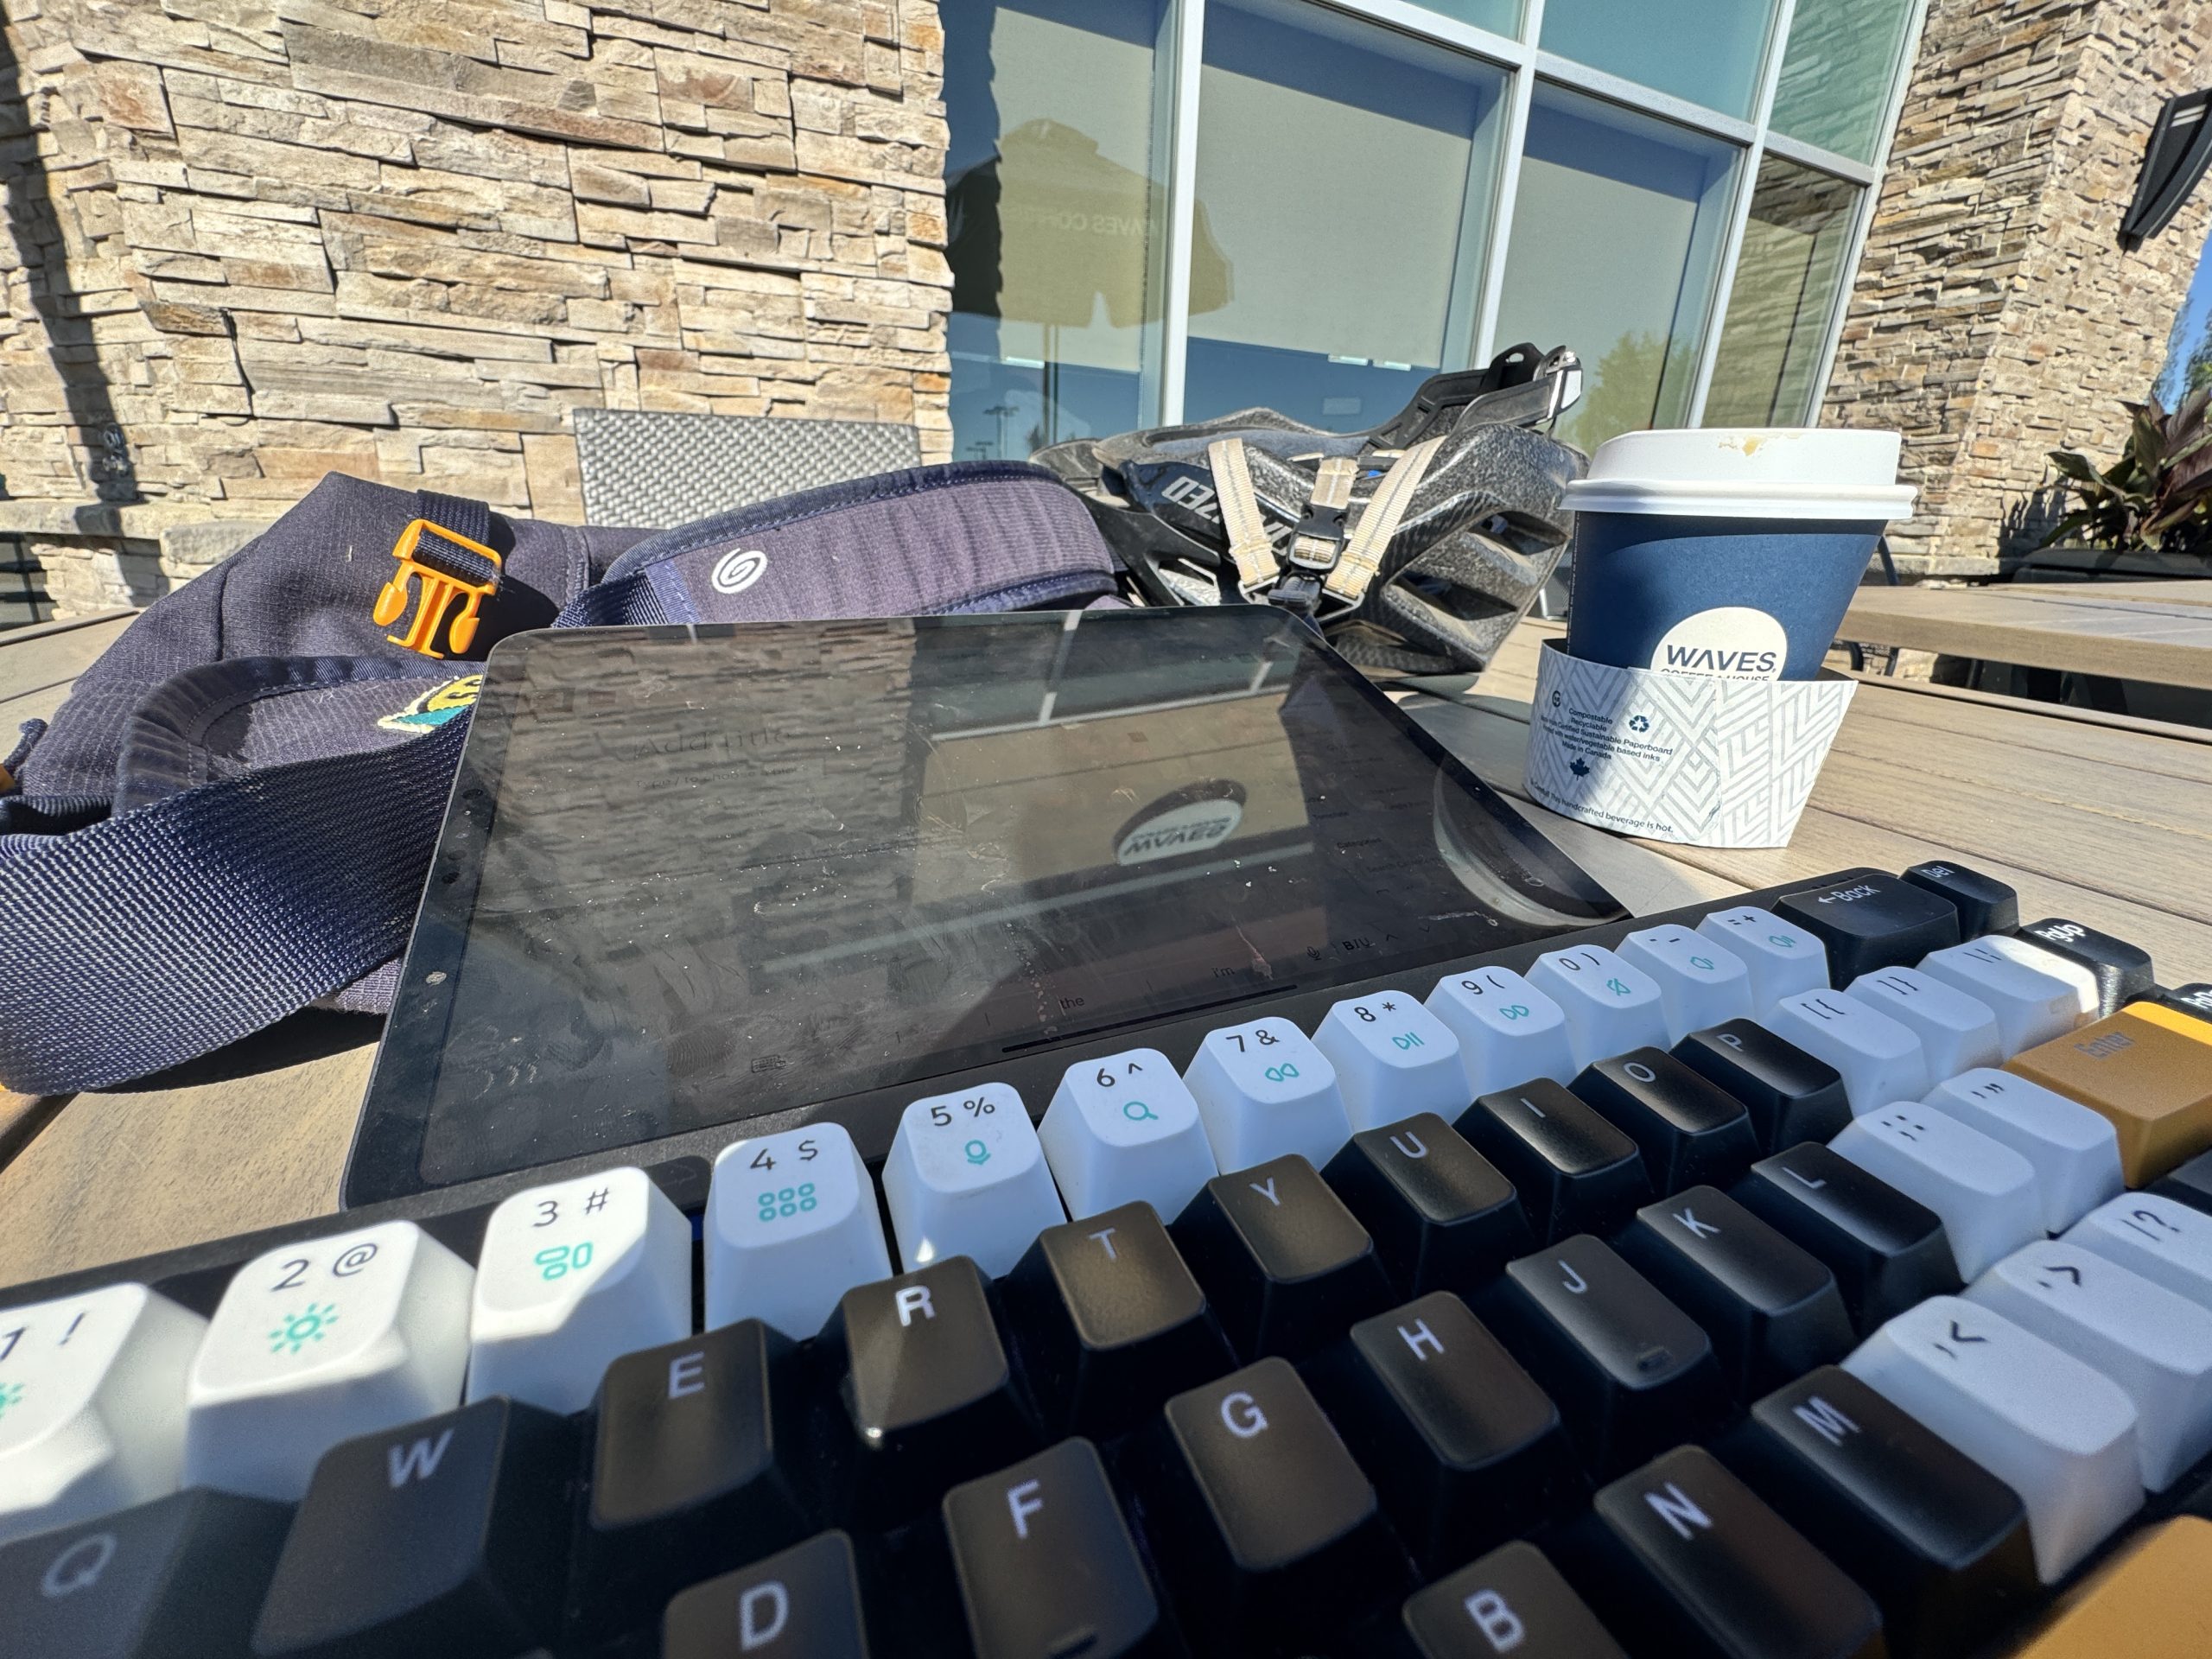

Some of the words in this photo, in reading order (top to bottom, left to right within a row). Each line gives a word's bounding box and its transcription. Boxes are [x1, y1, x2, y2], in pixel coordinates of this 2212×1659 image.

[1667, 644, 1777, 672] WAVES
[1568, 708, 1613, 725] Compostable
[1571, 717, 1607, 733] Recyclable
[1561, 740, 1577, 752] Made
[1585, 747, 1612, 760] Canada
[1564, 734, 1615, 752] water/vegetable
[1617, 746, 1642, 759] based
[1643, 752, 1661, 763] inks
[1580, 728, 1622, 745] Sustainable
[1623, 738, 1674, 756] Paperboard
[1561, 798, 1605, 819] handcrafted
[1605, 812, 1645, 829] beverage
[1646, 821, 1655, 830] is
[1656, 823, 1675, 834] hot.
[1920, 865, 1955, 879] Del
[1830, 883, 1882, 903] Back
[2033, 923, 2088, 944] PgUp
[1581, 951, 1601, 967] )
[1460, 979, 1484, 996] 9
[1486, 974, 1506, 990] (
[1059, 995, 1084, 1010] the
[1352, 1006, 1377, 1024] 8
[1225, 1033, 1247, 1054] 7
[1255, 1028, 1281, 1047] &
[1715, 1033, 1748, 1053] P
[2073, 1030, 2136, 1061] Enter
[1095, 1067, 1116, 1089] 6
[930, 1104, 954, 1128] 5
[962, 1096, 997, 1118] %
[749, 1147, 777, 1172] 4
[1389, 1129, 1428, 1160] U
[1248, 1176, 1281, 1208] Y
[1783, 1166, 1826, 1189] L
[531, 1199, 560, 1228] 3
[583, 1186, 611, 1216] #
[1672, 1207, 1721, 1240] K
[1088, 1226, 1120, 1262] T
[270, 1257, 311, 1293] 2
[331, 1242, 379, 1279] @
[1557, 1259, 1588, 1295] J
[893, 1284, 938, 1327] R
[58, 1310, 88, 1346] !
[1396, 1318, 1446, 1362] H
[667, 1351, 707, 1400] E
[1219, 1390, 1269, 1440] G
[1792, 1395, 1864, 1447] M
[386, 1427, 455, 1490] W
[1007, 1478, 1044, 1541] F
[1644, 1482, 1713, 1541] N
[739, 1579, 790, 1651] D
[1464, 1589, 1527, 1655] B
